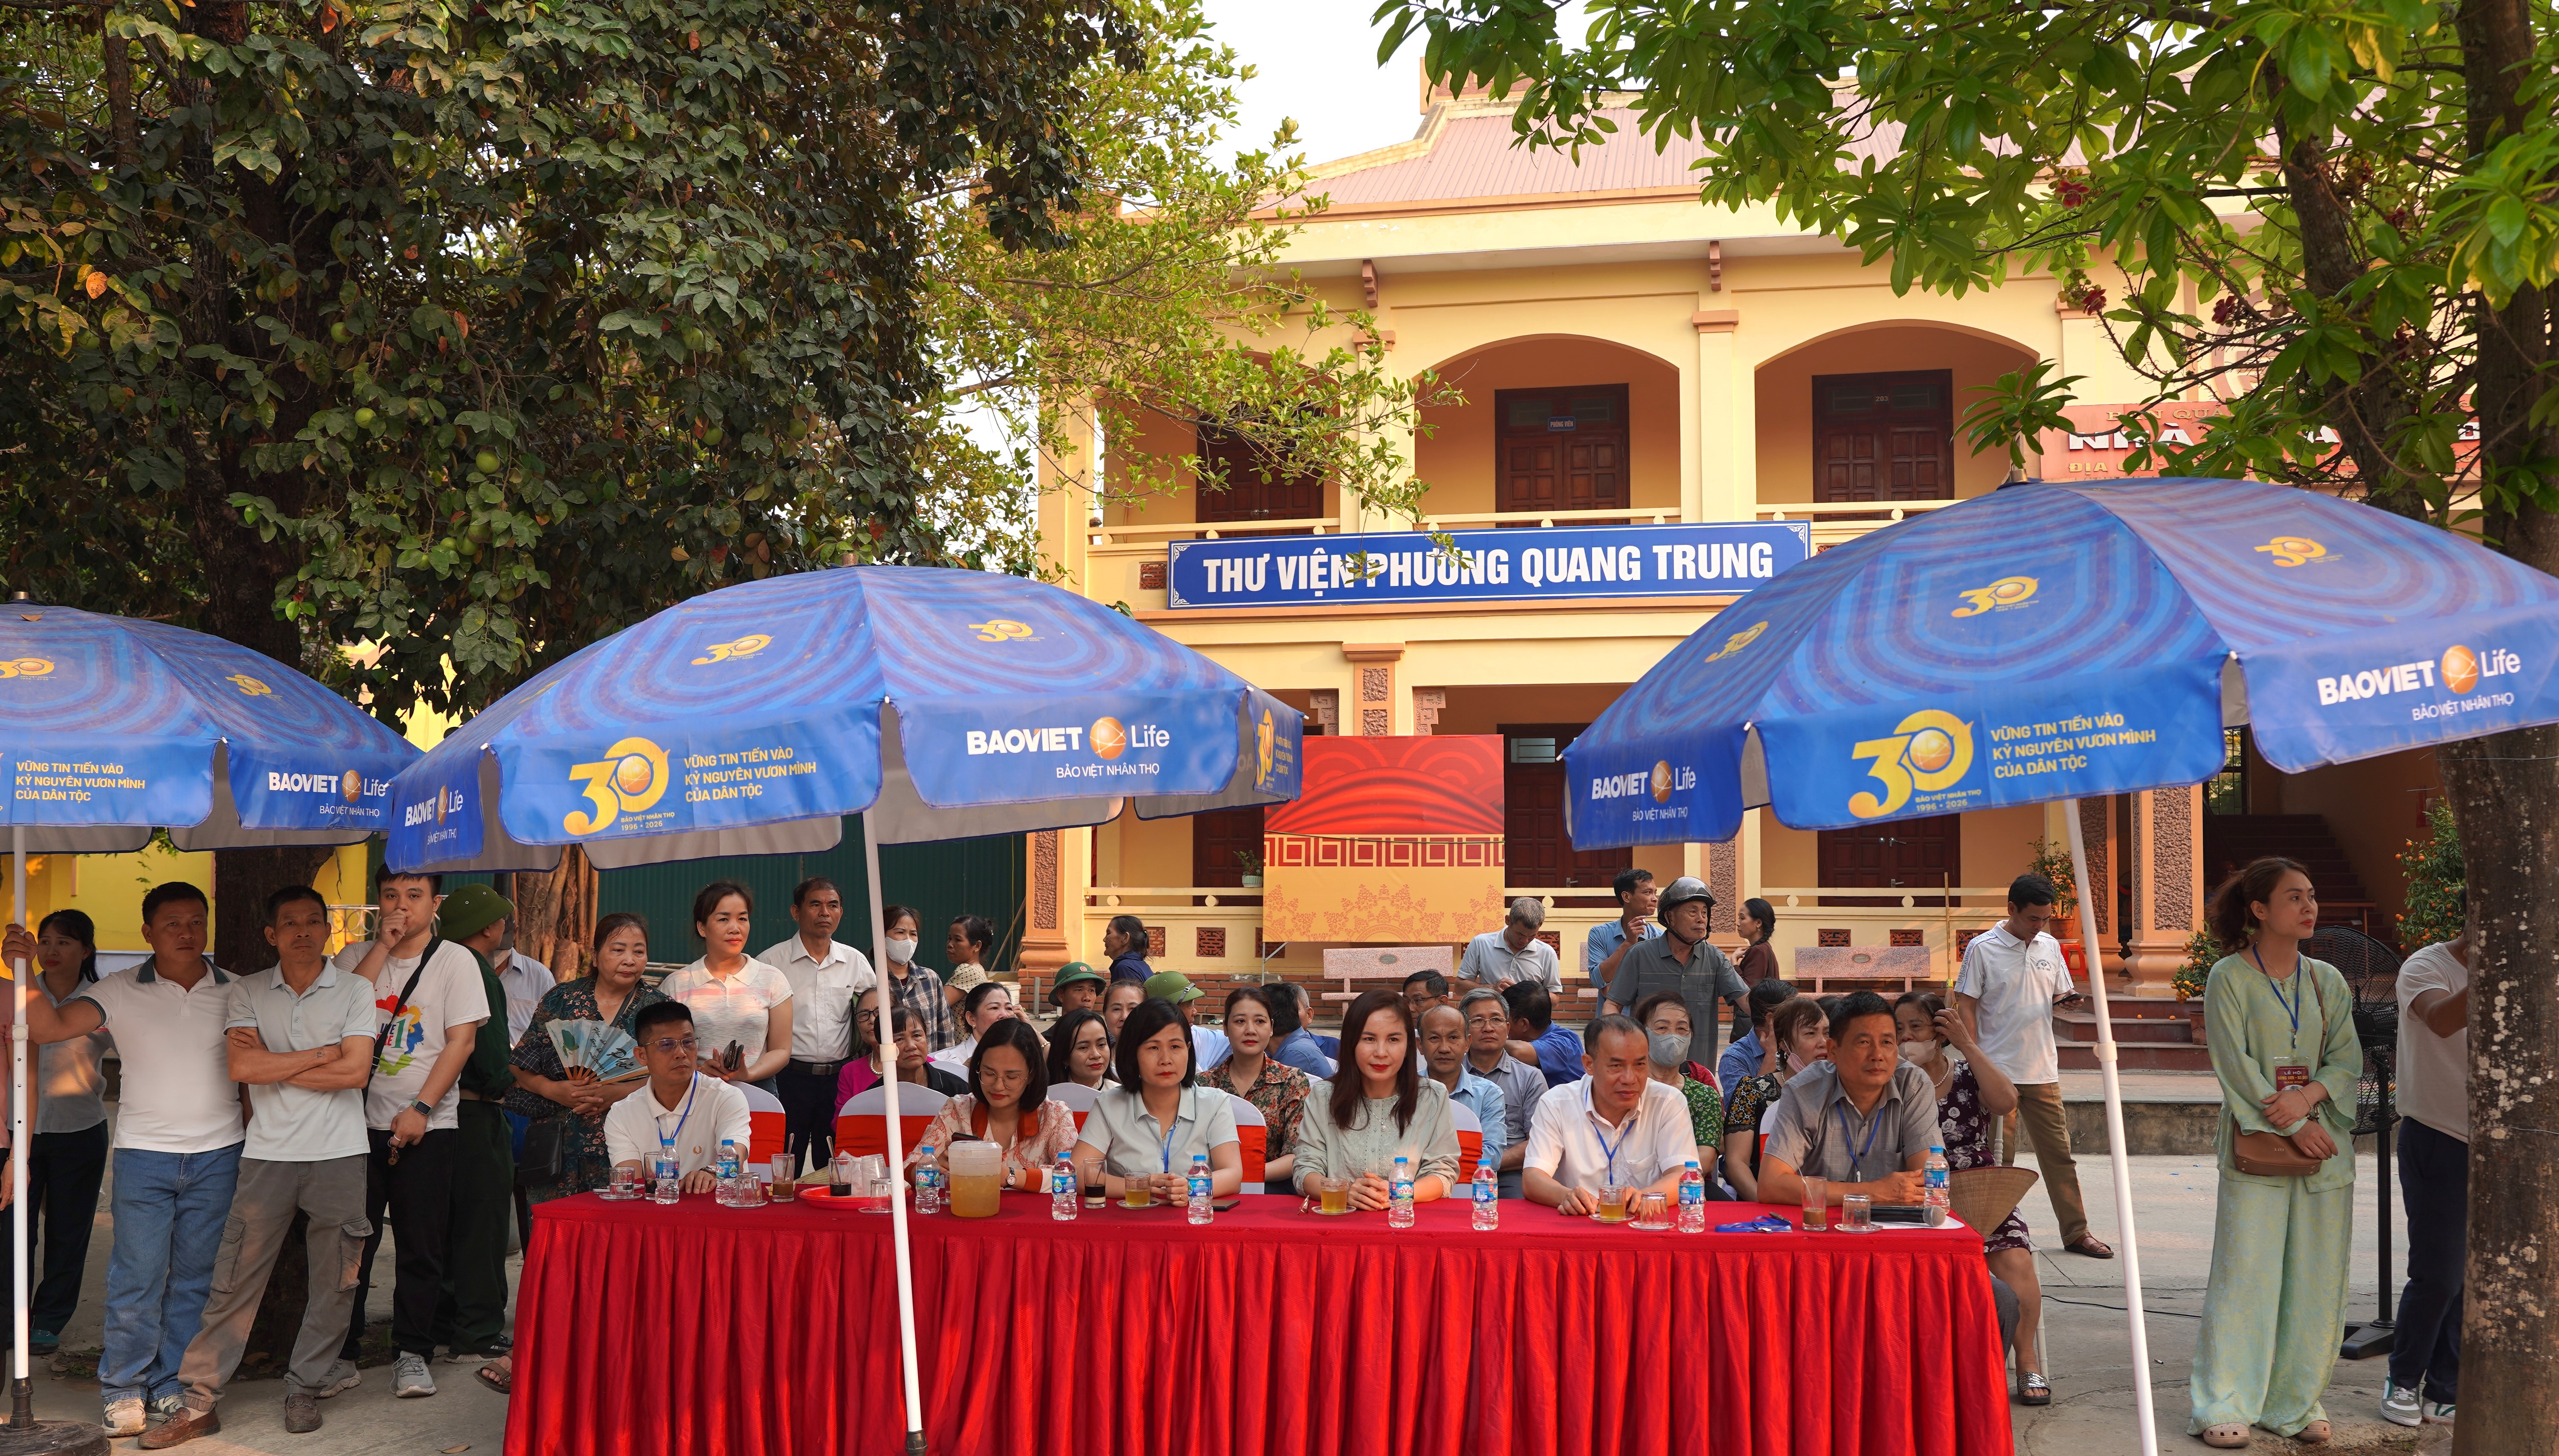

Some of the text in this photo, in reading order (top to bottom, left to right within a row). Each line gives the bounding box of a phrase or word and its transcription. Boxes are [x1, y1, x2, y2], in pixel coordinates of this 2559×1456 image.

[2069, 462, 2108, 475] ĐỊA
[1203, 554, 1270, 592] THƯ
[1277, 548, 1355, 597] VIỆN
[1521, 545, 1641, 587] QUANG
[1653, 542, 1773, 580] TRUNG
[2317, 648, 2521, 706] BAOVIET Life
[2411, 703, 2437, 721] BẢO
[2461, 695, 2491, 712] NHÂN
[2492, 692, 2515, 707] THỌ
[1990, 712, 2124, 742] VỮNG TIN TIẾN VÀO
[966, 724, 1170, 755] BAOVIET Life
[1993, 728, 2156, 760] KỶ NGUYÊN VƯƠN MÌNH
[16, 760, 123, 774] VỮNG TIN TIẾN VÀO
[684, 746, 793, 769] VỮNG TIN TIẾN VÀO
[1994, 754, 2087, 778] CỦA DÂN TỘC
[685, 761, 816, 786] KỶ NGUYÊN VƯƠN MÌNH
[1056, 762, 1160, 779] BẢO VIỆT NHÂN THỌ
[16, 774, 145, 789] KỶ NGUYÊN VƯƠN MÌNH
[269, 772, 386, 797] BAOVIET Life
[1591, 766, 1696, 800] BAOVIET Life
[16, 788, 91, 803] CỦA DÂN TỘC
[685, 783, 763, 802] CỦA DÂN TỘC
[1947, 791, 1967, 799] NHÂN
[320, 803, 380, 818] BẢO VIỆT NHÂN THỌ
[405, 790, 463, 827] BAOVIET Life
[1633, 806, 1688, 822] BẢO VIỆT NHÂN THỌ
[1917, 799, 1968, 812] 1996 2026
[634, 813, 645, 822] VIỆT
[646, 821, 663, 829] 2026
[449, 828, 457, 839] THỌ
